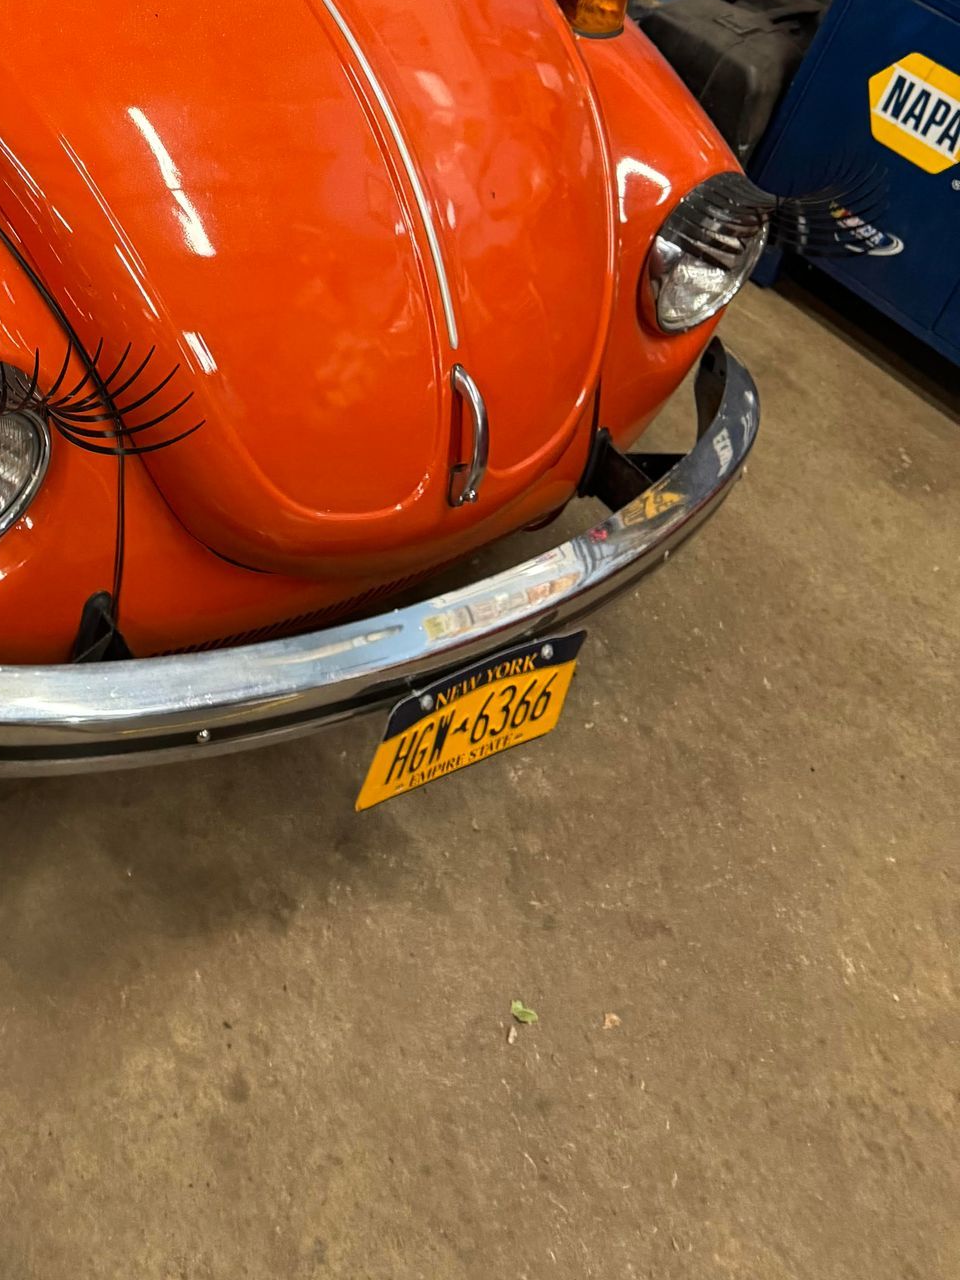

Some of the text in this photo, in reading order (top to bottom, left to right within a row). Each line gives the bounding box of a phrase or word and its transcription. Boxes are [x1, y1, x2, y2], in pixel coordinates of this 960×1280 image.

[882, 75, 960, 154] NAPA
[435, 652, 538, 710] NEW YORK
[409, 734, 514, 787] EMPIRE STATE
